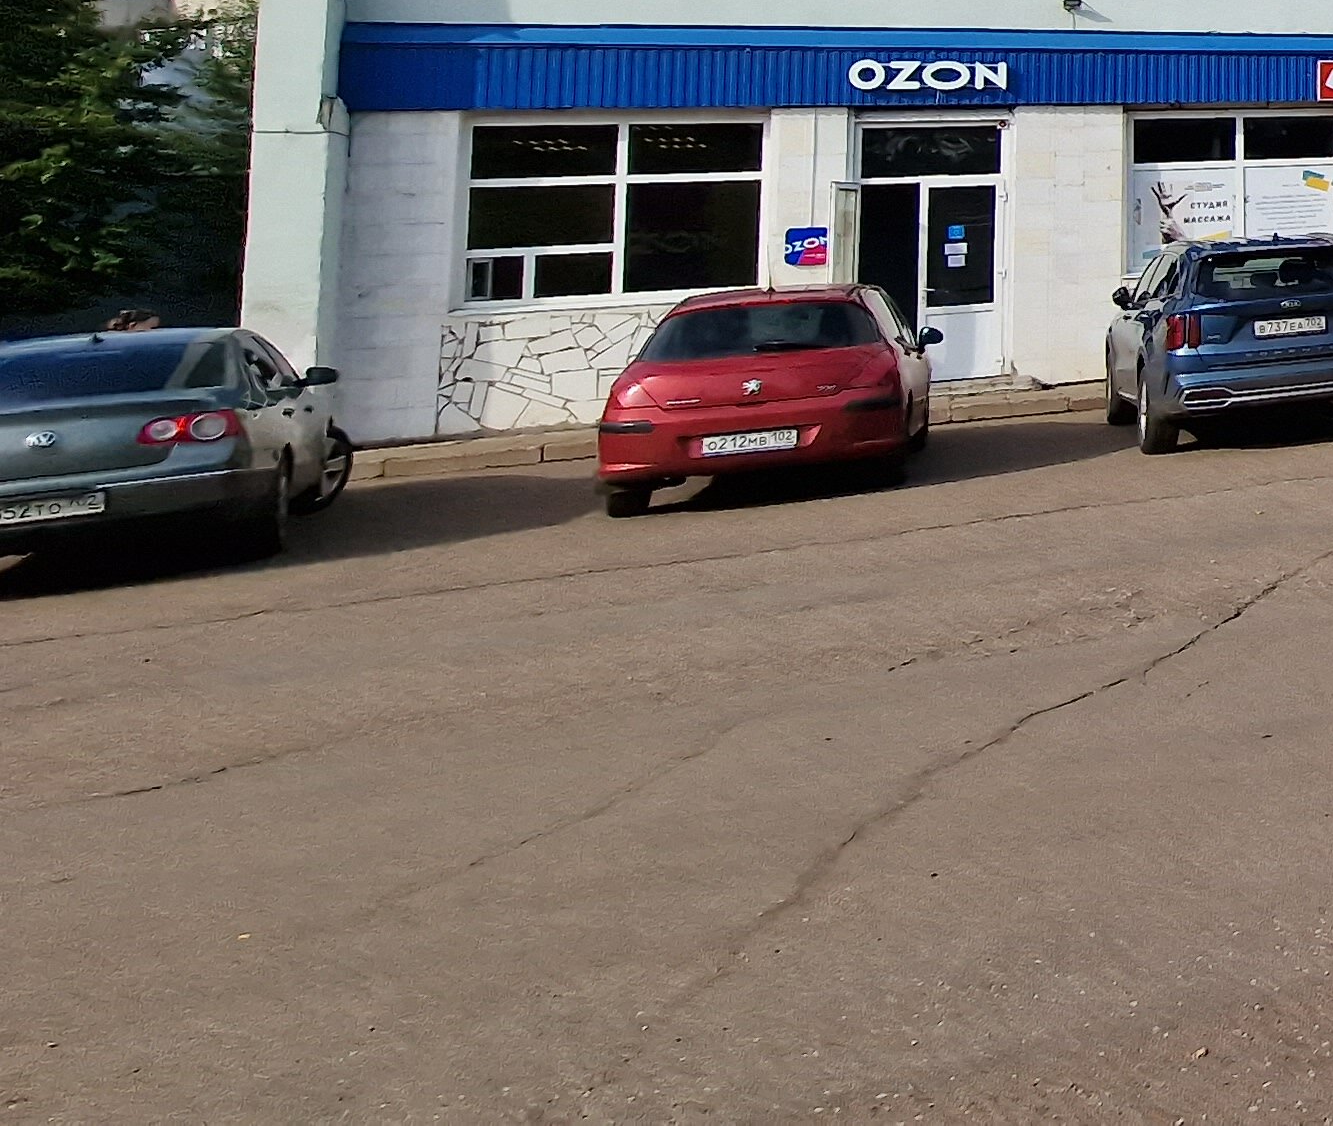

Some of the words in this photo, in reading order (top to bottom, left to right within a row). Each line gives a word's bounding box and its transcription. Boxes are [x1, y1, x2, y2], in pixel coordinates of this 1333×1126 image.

[848, 59, 1008, 90] OZON
[1190, 200, 1228, 209] СТУДИЯ
[1183, 214, 1231, 224] МАССАЖА
